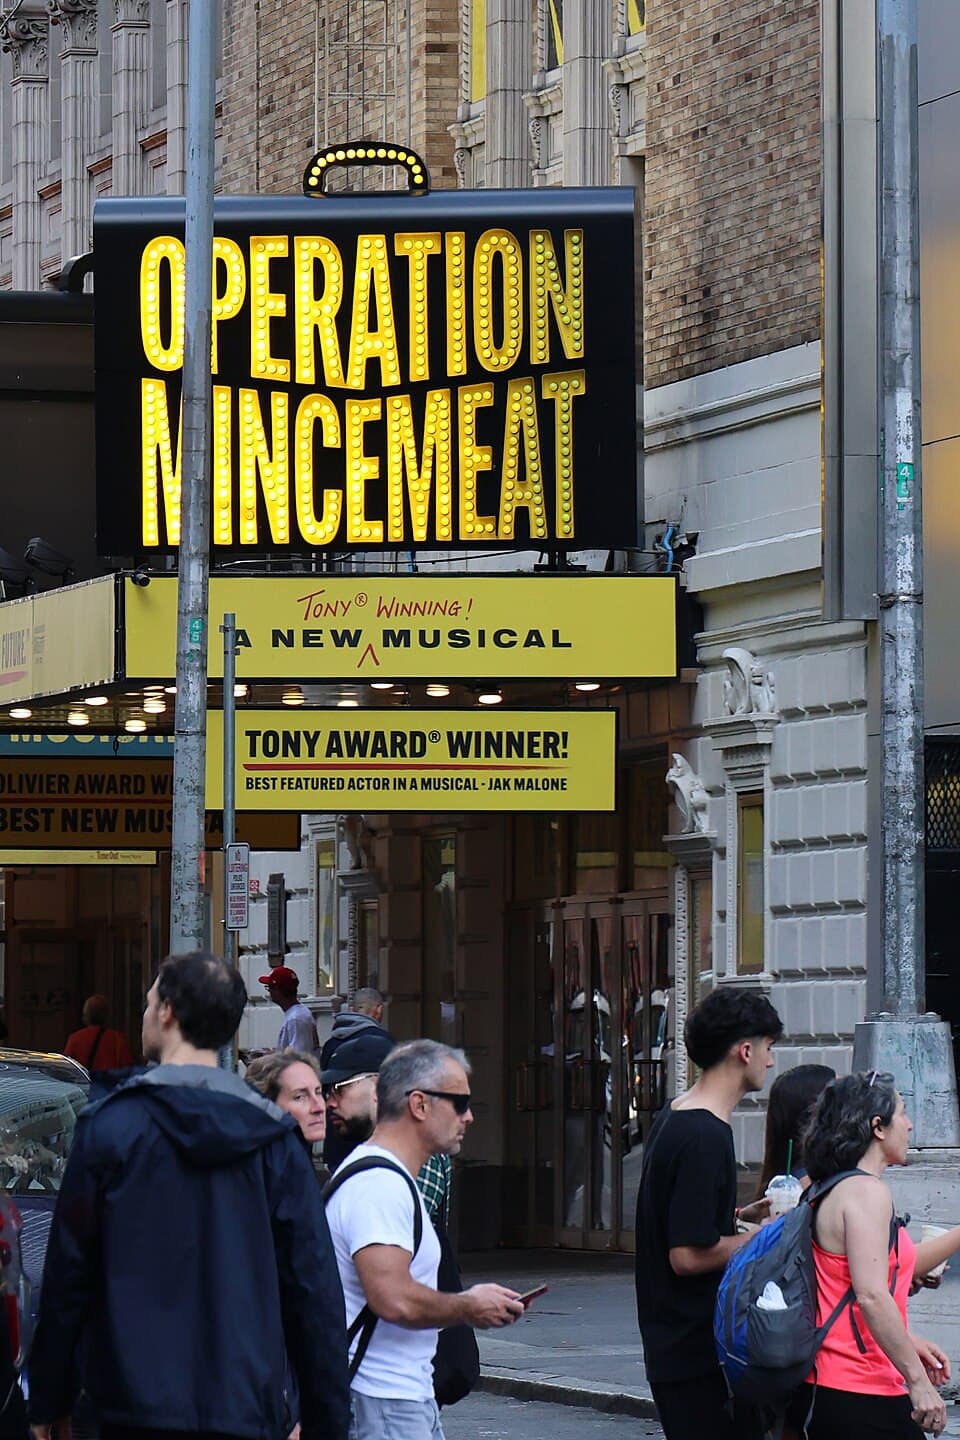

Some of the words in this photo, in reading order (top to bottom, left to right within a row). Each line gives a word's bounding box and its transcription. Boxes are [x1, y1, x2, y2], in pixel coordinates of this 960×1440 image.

[139, 228, 586, 390] OPERATION
[141, 368, 586, 548] MINCEMEAT
[234, 629, 253, 648] A
[271, 629, 362, 648] NEW
[382, 629, 573, 648] MUSICAL
[245, 730, 321, 758] TONY
[446, 731, 569, 759] WINNER!
[75, 773, 145, 795] AWARD
[246, 777, 278, 790] BEST
[280, 777, 345, 791] FEATURED
[347, 777, 390, 791] ACTOR
[393, 777, 407, 790] IN
[409, 777, 418, 790] A
[421, 777, 478, 791] MUSICAL
[488, 777, 511, 791] JAK
[513, 777, 568, 791] MALONE
[60, 808, 119, 833] NEW
